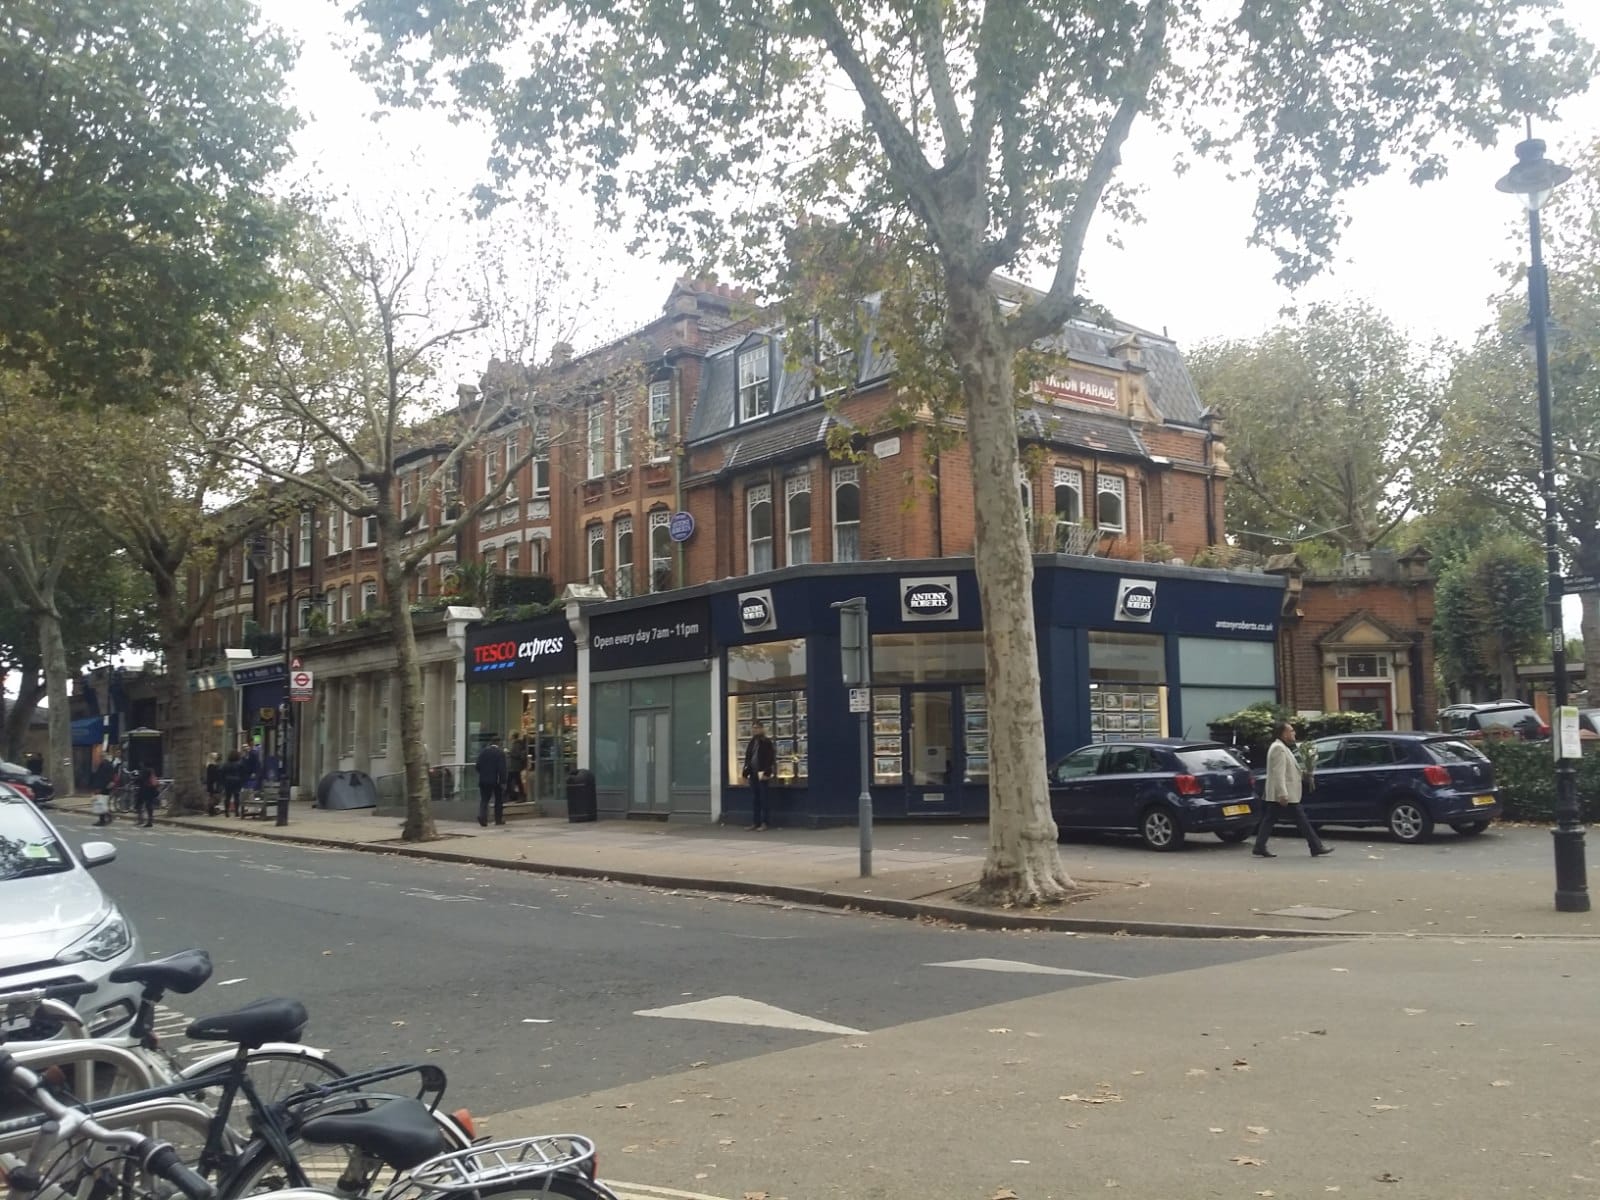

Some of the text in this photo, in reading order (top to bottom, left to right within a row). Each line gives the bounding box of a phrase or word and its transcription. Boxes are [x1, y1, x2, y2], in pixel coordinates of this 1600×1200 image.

[1080, 381, 1116, 400] PARADE
[911, 592, 947, 601] ANTONY
[910, 599, 948, 608] ROBERTS
[1215, 620, 1274, 631] antonyroberts.co.uk
[593, 635, 614, 650] Open
[614, 633, 635, 646] every
[635, 628, 651, 644] day
[651, 627, 670, 640] 7am
[675, 622, 699, 638] 11pm
[473, 636, 564, 663] TESCO express
[292, 658, 301, 668] A
